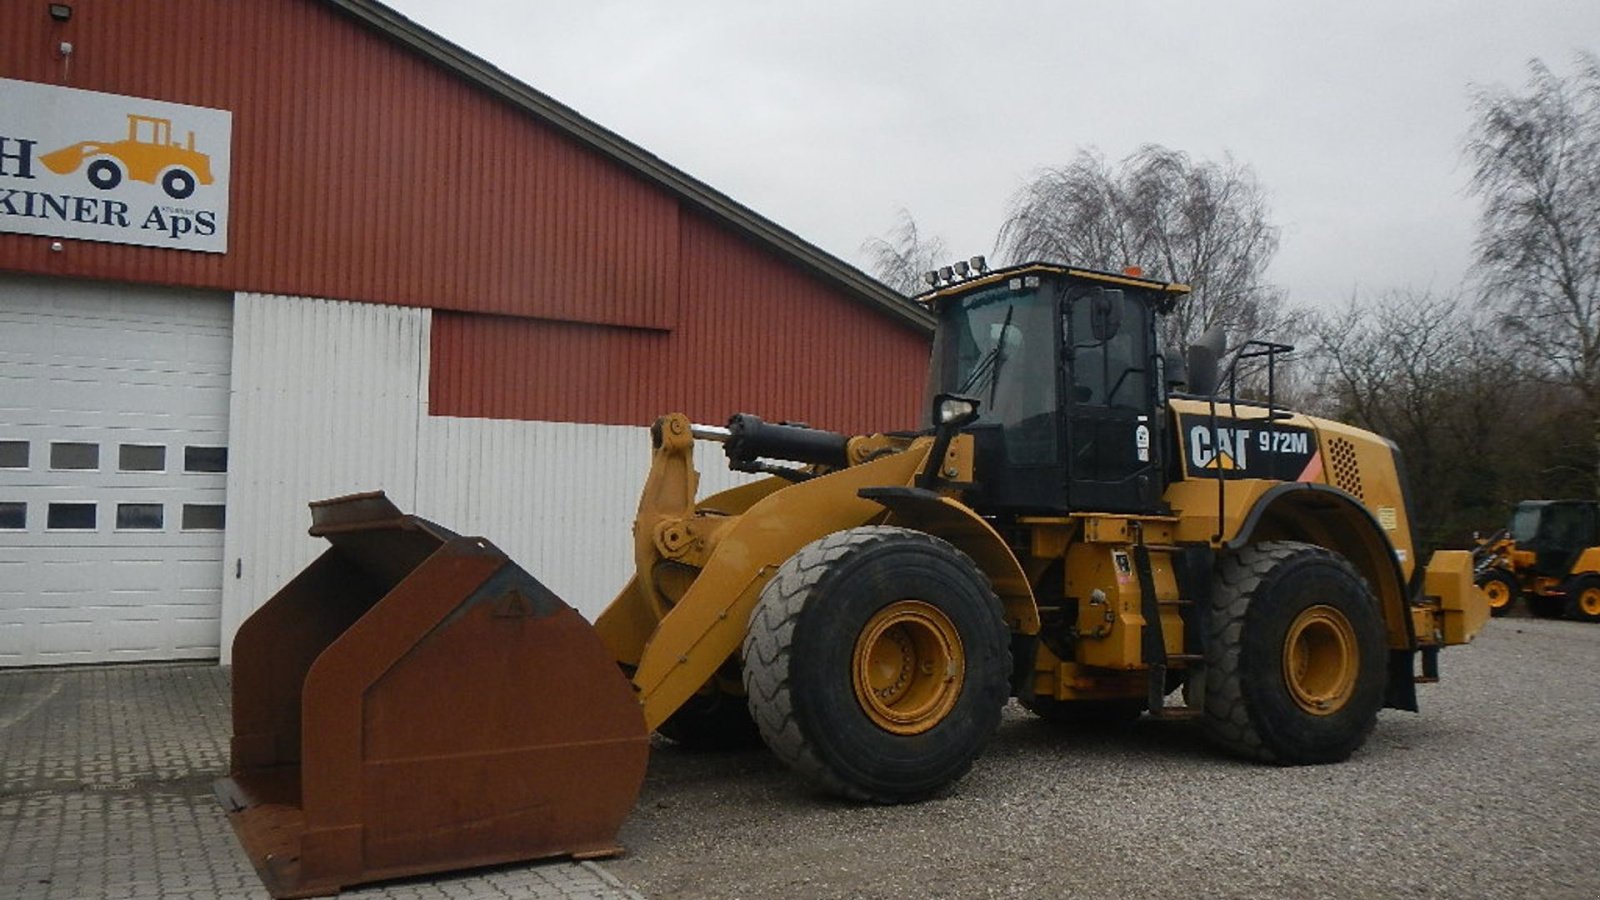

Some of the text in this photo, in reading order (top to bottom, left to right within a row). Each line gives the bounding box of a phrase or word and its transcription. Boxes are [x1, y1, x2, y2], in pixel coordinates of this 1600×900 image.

[141, 205, 216, 239] ApS
[1190, 425, 1250, 470] CAT
[1259, 430, 1308, 454] 972M
